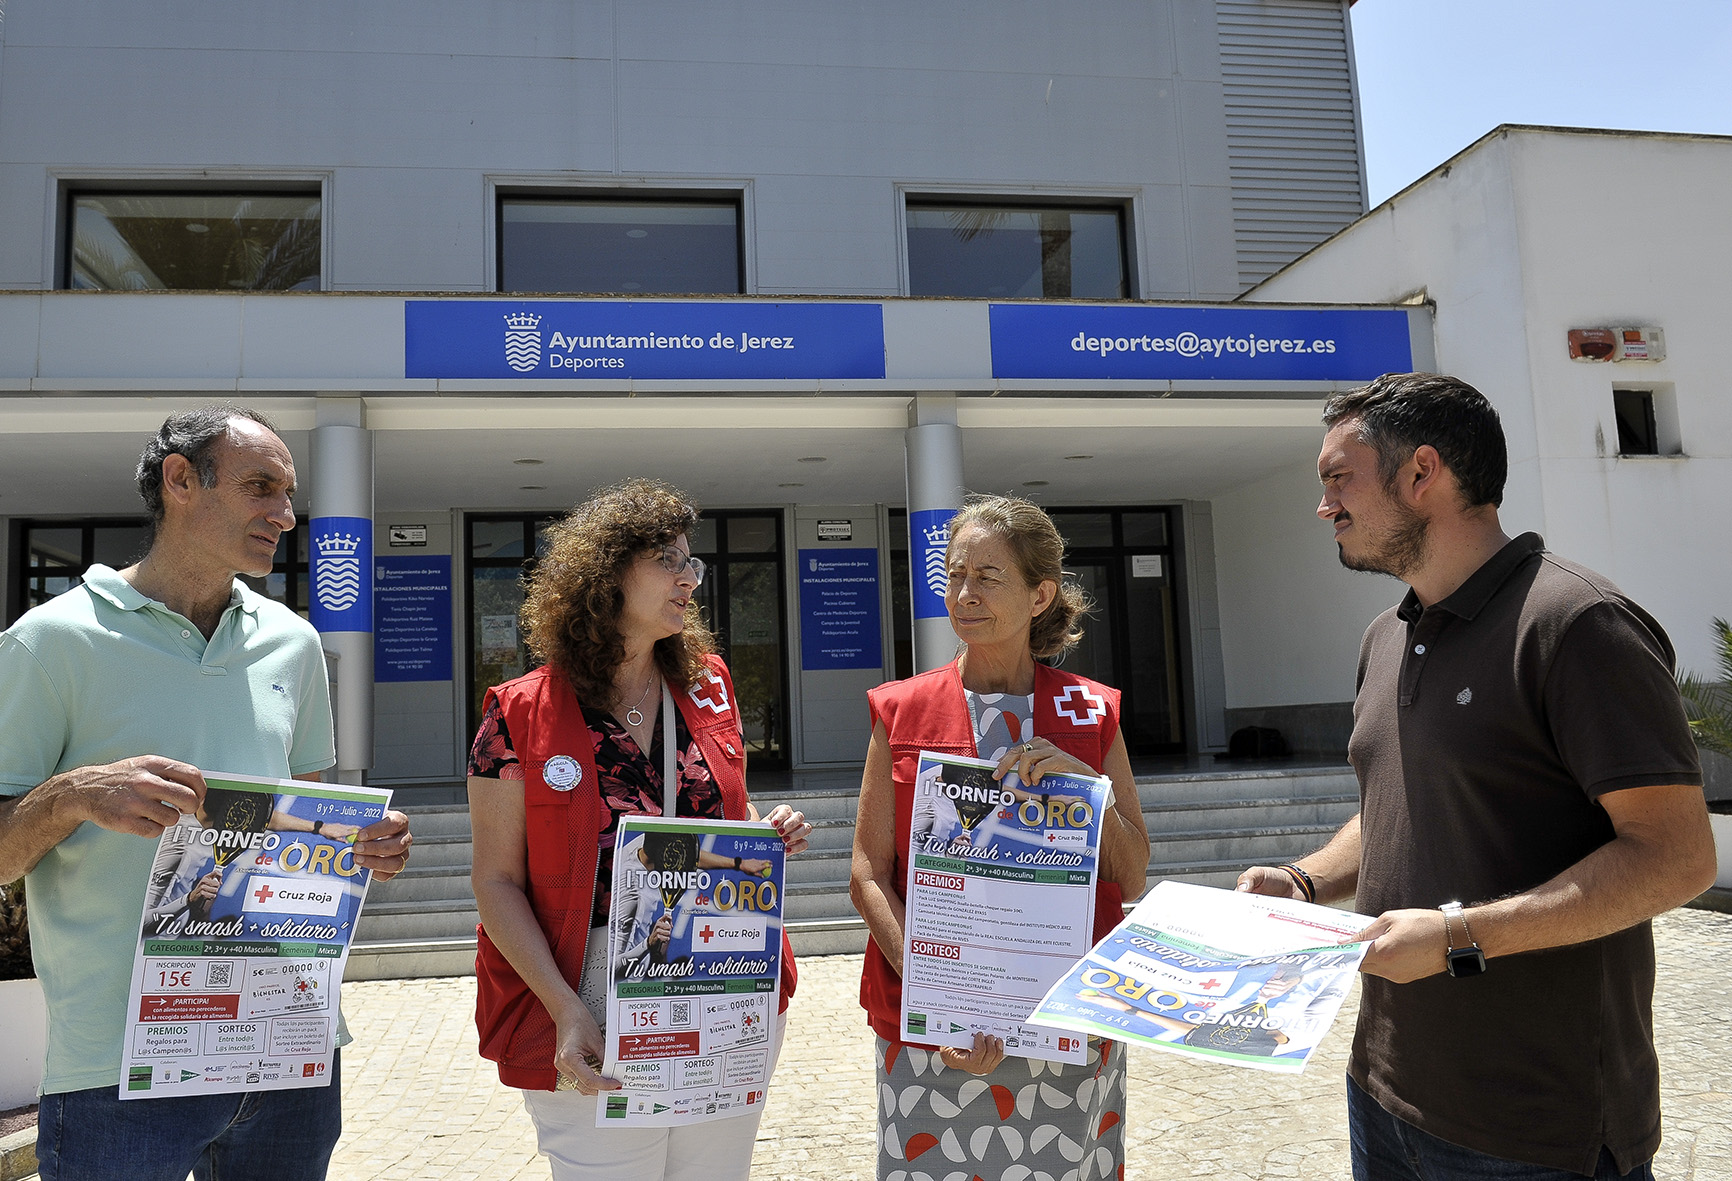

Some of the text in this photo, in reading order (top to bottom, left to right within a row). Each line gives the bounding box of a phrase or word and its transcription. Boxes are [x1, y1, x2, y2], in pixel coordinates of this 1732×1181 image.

[548, 331, 794, 352] Ayuntamiento de Jerez
[1070, 331, 1336, 358] deportes@aytojerez.es
[550, 354, 626, 370] Deportes
[1063, 781, 1078, 789] Julio
[934, 782, 1015, 806] TORNEO
[317, 803, 381, 817] 8 y 9 Julio 2022
[998, 809, 1014, 820] de
[1018, 800, 1093, 828] ORO
[188, 826, 280, 851] TORNEO
[734, 841, 783, 852] 8 y 9 Julio 2022
[948, 844, 999, 860] smash
[255, 853, 273, 865] de
[635, 871, 710, 890] TORNEO
[917, 873, 962, 889] PREMIOS
[989, 868, 1001, 876] +40
[1002, 869, 1034, 880] Masculina
[279, 891, 332, 903] Cruz Roja
[695, 894, 709, 905] de
[713, 879, 778, 912] ORO
[185, 915, 245, 936] smash
[1132, 926, 1158, 936] Mixta
[718, 929, 760, 939] Cruz Roja
[243, 945, 277, 954] Masculina
[913, 941, 958, 958] SORTEOS
[1160, 934, 1200, 950] Femenina
[282, 963, 312, 974] 00000
[648, 956, 694, 977] smash
[1128, 961, 1192, 985] Roja Cruz
[159, 971, 192, 986] 15€
[1080, 968, 1188, 1010] ORO
[173, 998, 210, 1006] ¡PARTICIPA!
[730, 998, 754, 1010] 00000
[1046, 999, 1067, 1010] 2022
[1078, 1008, 1100, 1018] Julio
[1195, 1000, 1216, 1010] de
[632, 1011, 658, 1027] 15€
[147, 1025, 256, 1035] PREMIOS SORTEOS
[626, 1059, 714, 1072] PREMIOS SORTEOS
